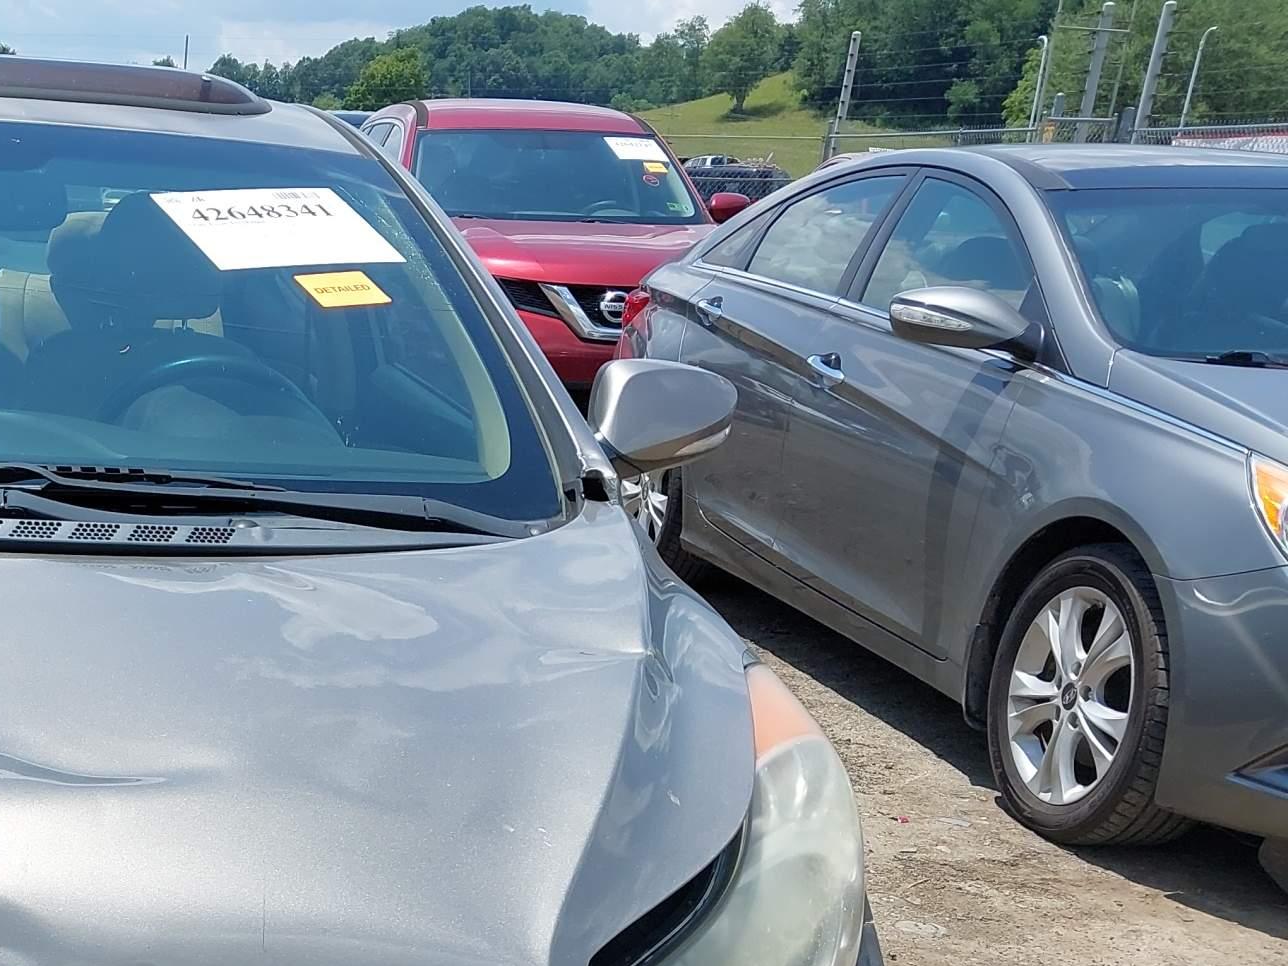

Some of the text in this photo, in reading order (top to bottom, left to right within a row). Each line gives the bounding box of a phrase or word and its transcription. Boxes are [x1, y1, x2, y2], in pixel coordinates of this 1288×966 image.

[191, 203, 334, 222] 42648341
[313, 284, 371, 294] DETAILED
[604, 302, 624, 310] NISS
